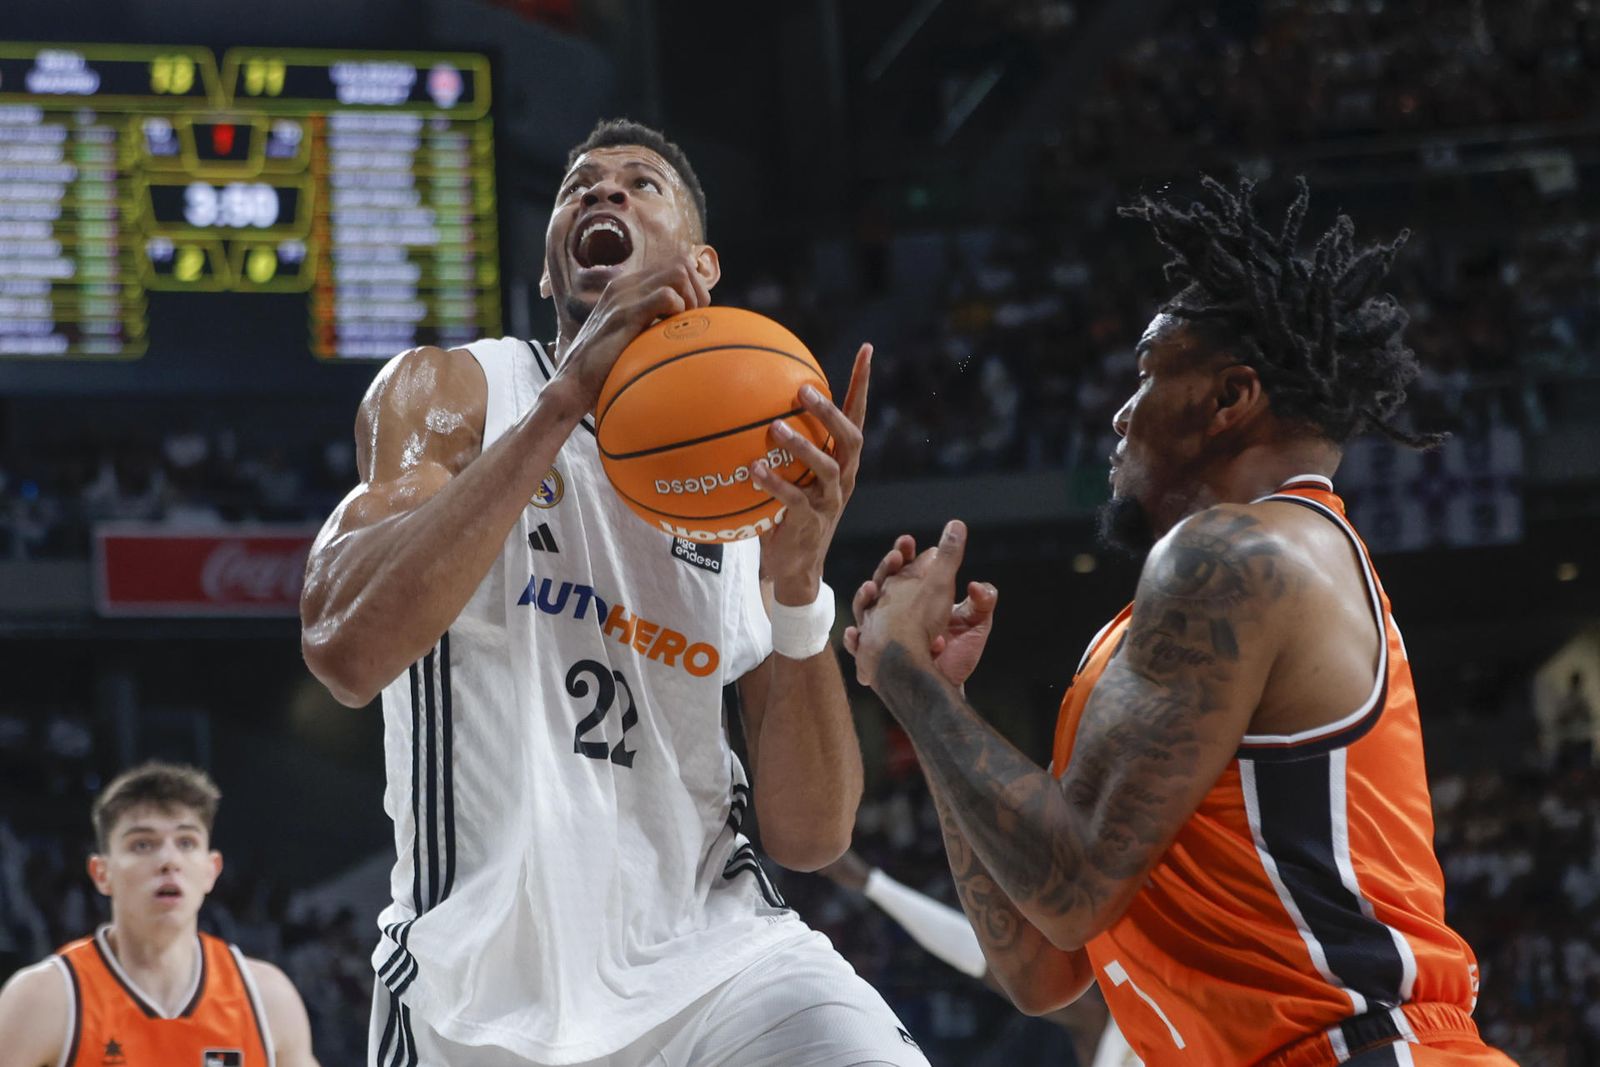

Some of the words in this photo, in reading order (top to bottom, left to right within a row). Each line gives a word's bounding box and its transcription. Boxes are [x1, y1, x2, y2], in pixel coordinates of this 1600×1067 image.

[655, 466, 750, 495] endesa
[675, 545, 720, 570] endesa
[565, 659, 638, 768] 22
